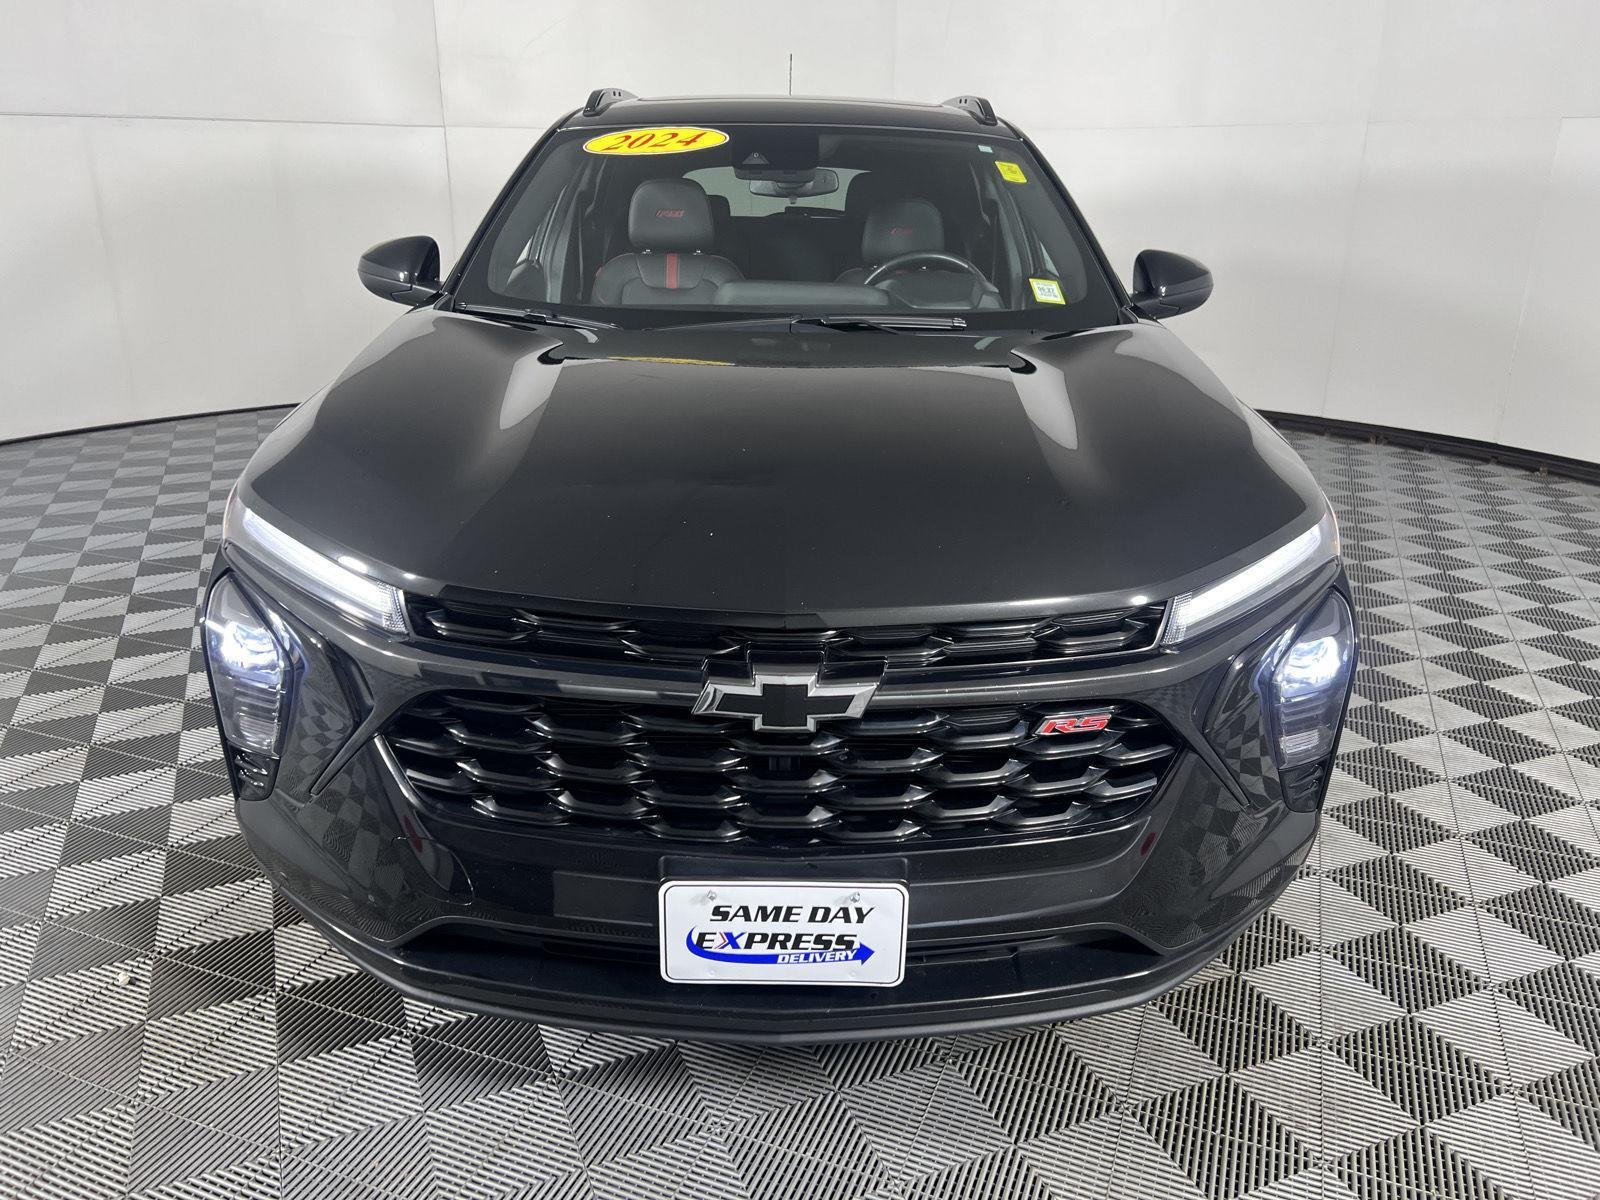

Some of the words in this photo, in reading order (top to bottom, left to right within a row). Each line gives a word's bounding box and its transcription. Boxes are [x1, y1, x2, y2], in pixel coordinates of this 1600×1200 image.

[602, 132, 707, 151] 2024
[1036, 713, 1112, 735] RS
[710, 905, 802, 922] SAME
[807, 906, 875, 924] DAY
[696, 932, 858, 951] EXPRESS
[777, 950, 858, 964] DELIVERY
